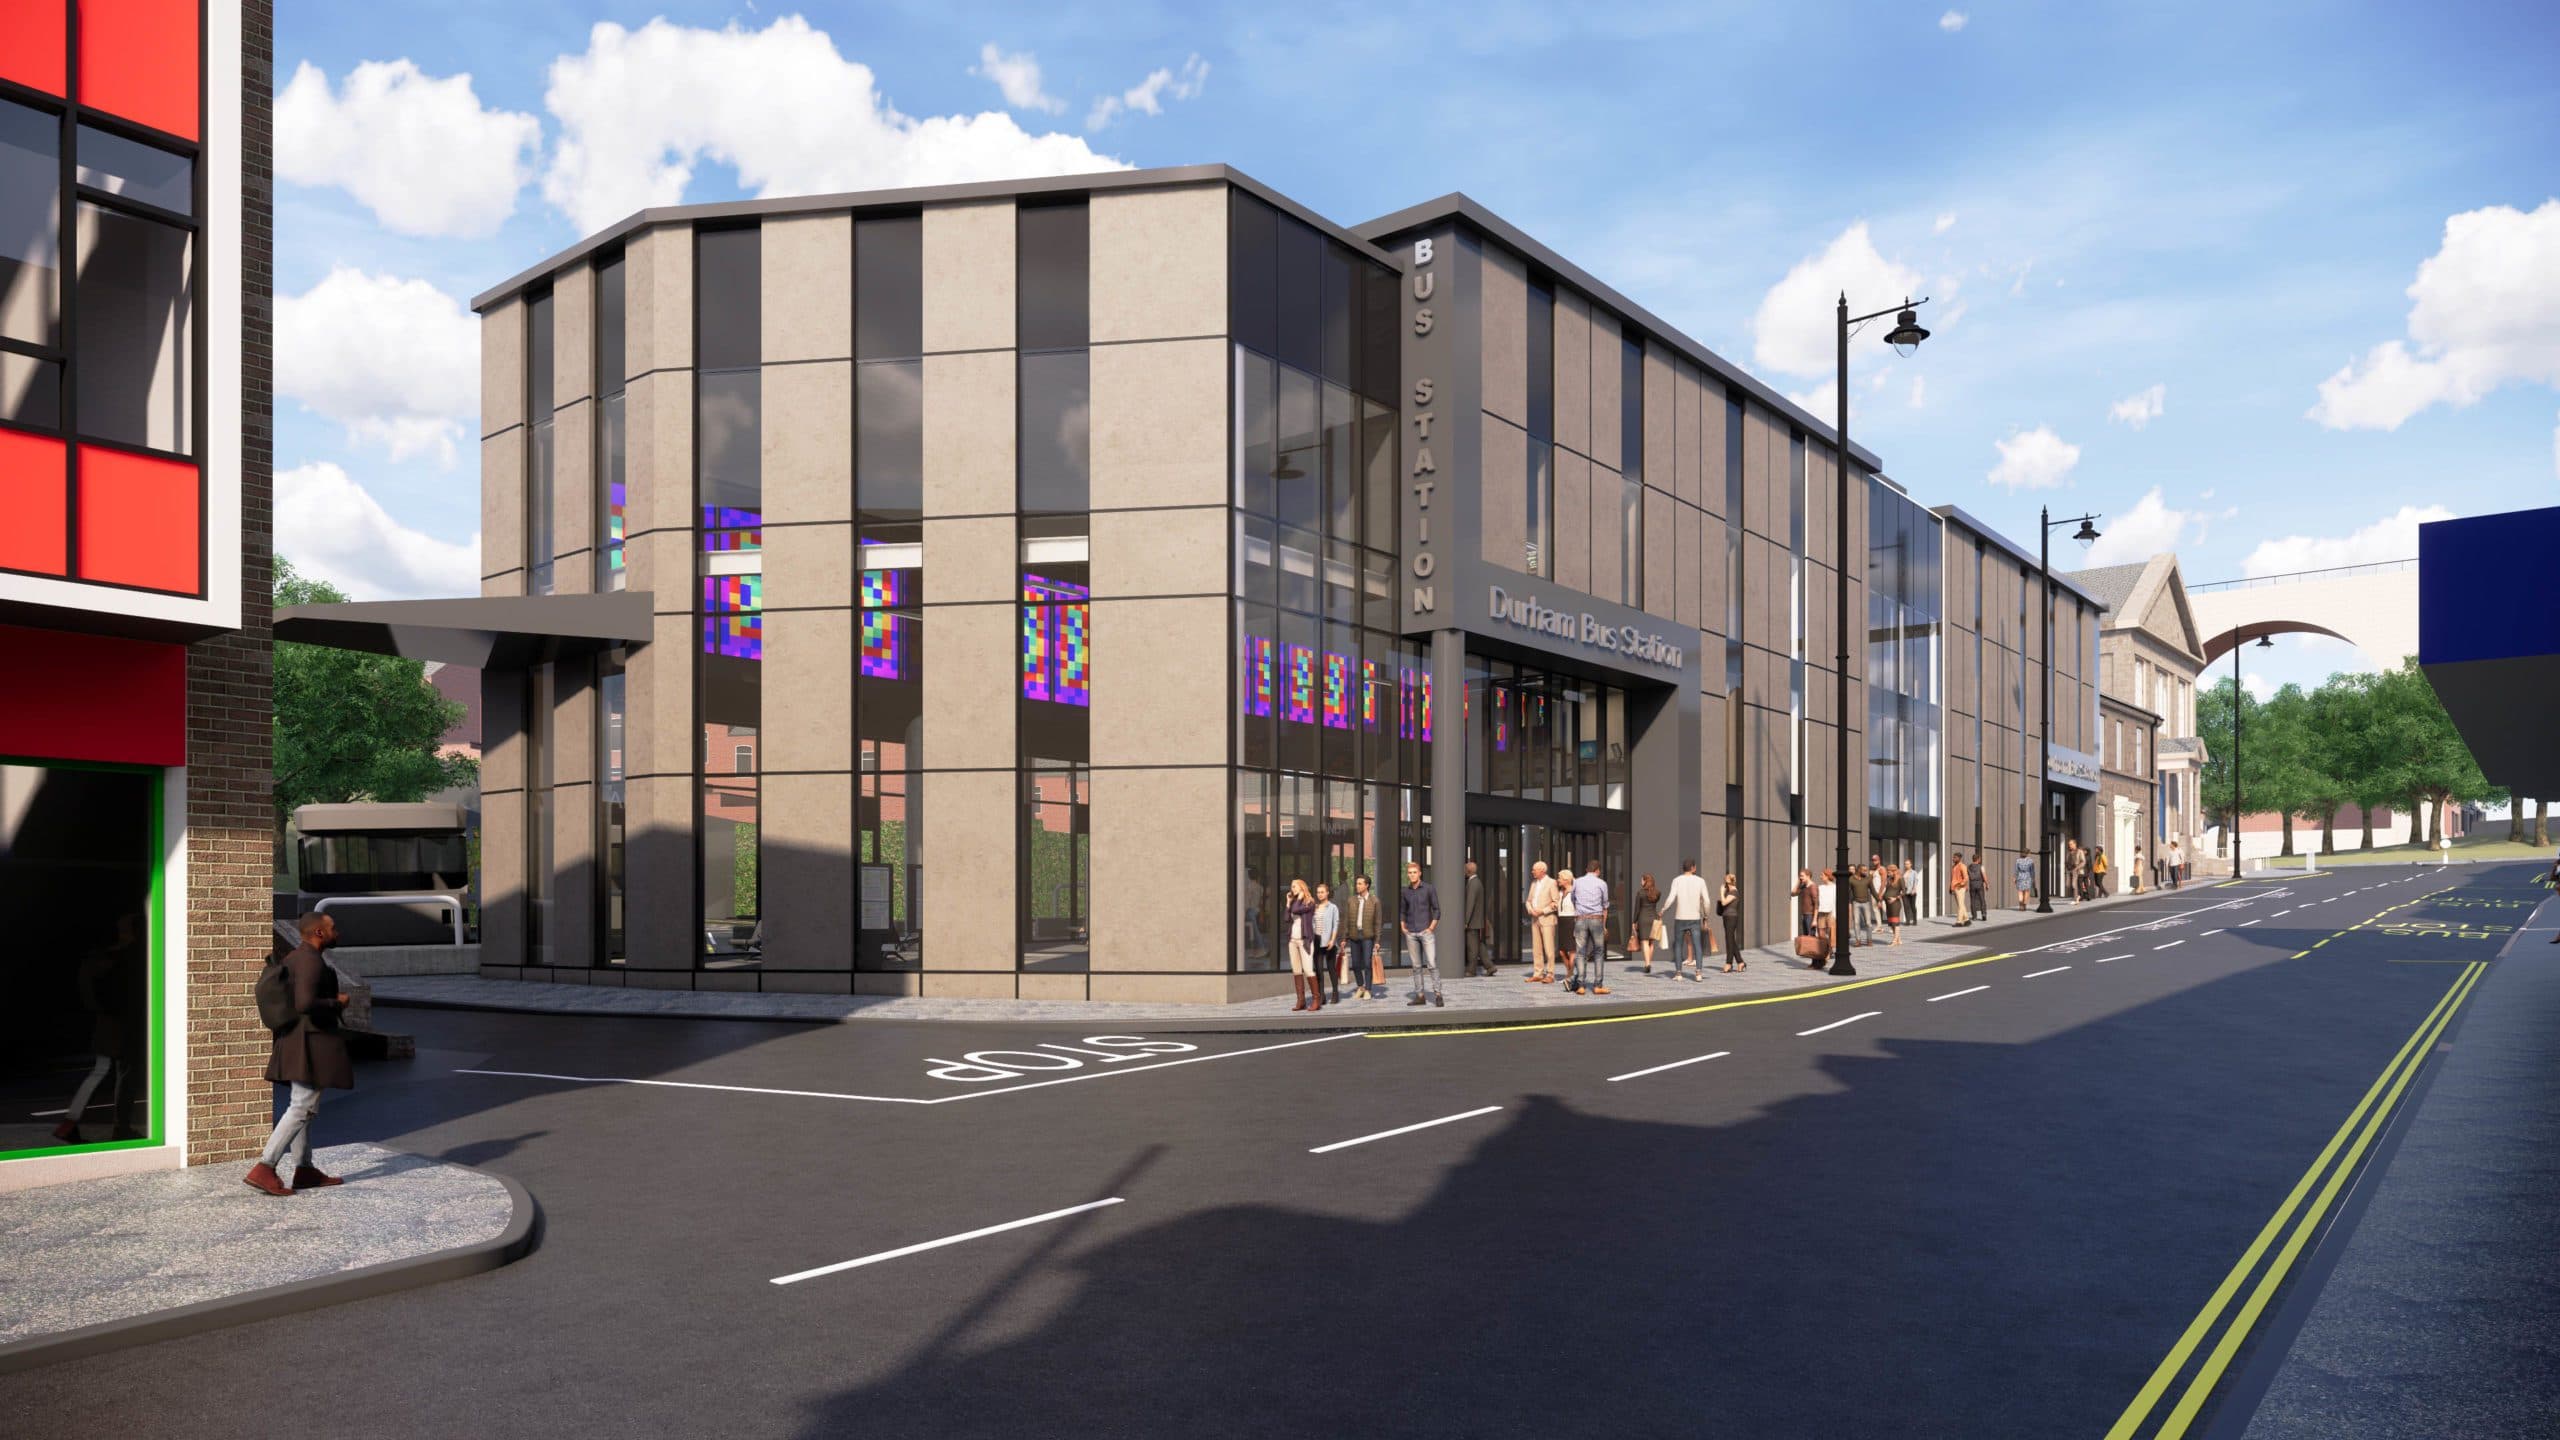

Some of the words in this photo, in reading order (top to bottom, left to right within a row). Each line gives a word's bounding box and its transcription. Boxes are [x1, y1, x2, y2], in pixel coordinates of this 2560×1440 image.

[1414, 238, 1434, 335] BUS
[1413, 377, 1435, 614] STATION
[1489, 585, 1575, 639] Durham
[1580, 612, 1617, 651] Bus
[1620, 625, 1682, 669] Station
[922, 1035, 1198, 1082] STOP
